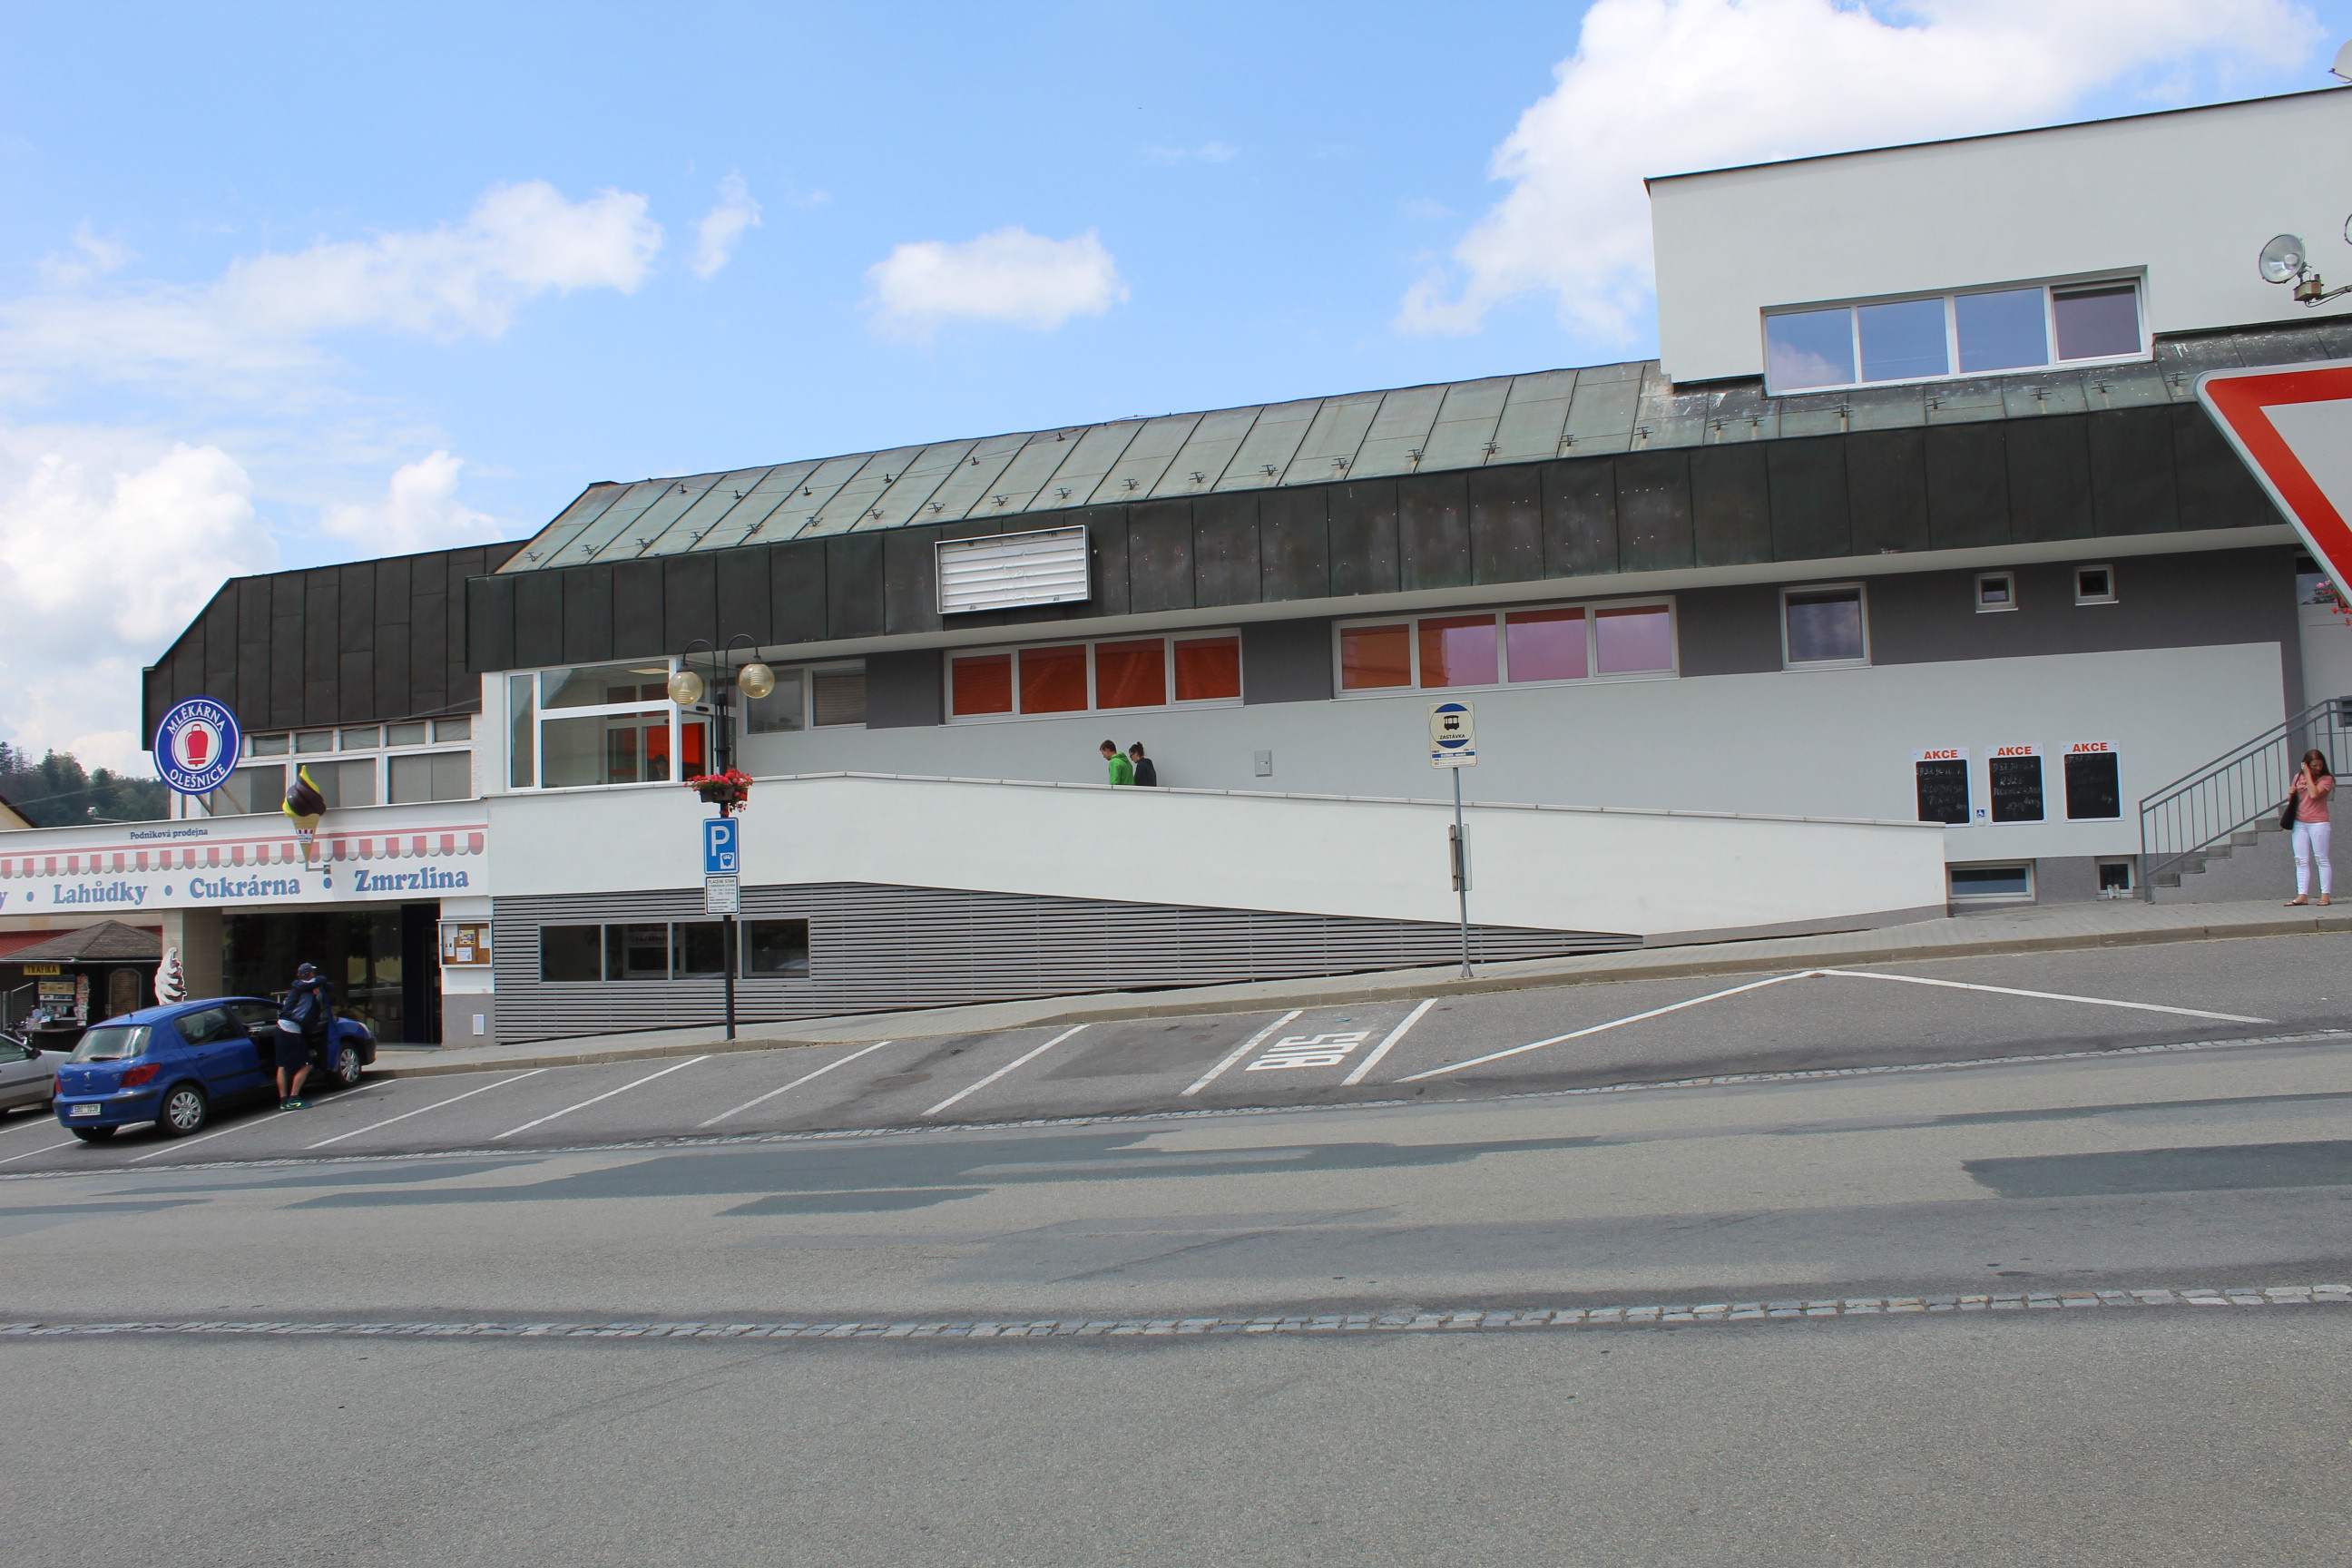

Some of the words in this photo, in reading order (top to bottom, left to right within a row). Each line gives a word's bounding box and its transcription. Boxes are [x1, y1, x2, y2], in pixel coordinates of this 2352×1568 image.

[167, 702, 226, 734] MLÉKÁRNA
[1924, 750, 1958, 760] AKCE
[1997, 746, 2032, 756] AKCE
[2073, 742, 2108, 752] AKCE
[170, 763, 226, 788] OLEŠNICE
[130, 828, 171, 839] Podniková
[172, 828, 209, 838] prodejna
[710, 825, 730, 857] P
[53, 880, 148, 906] Lahůdky
[189, 874, 301, 899] Cukrárna
[354, 867, 470, 892] Zmrzlina
[26, 965, 57, 974] TRAFIKA
[1244, 1031, 1371, 1072] BUS
